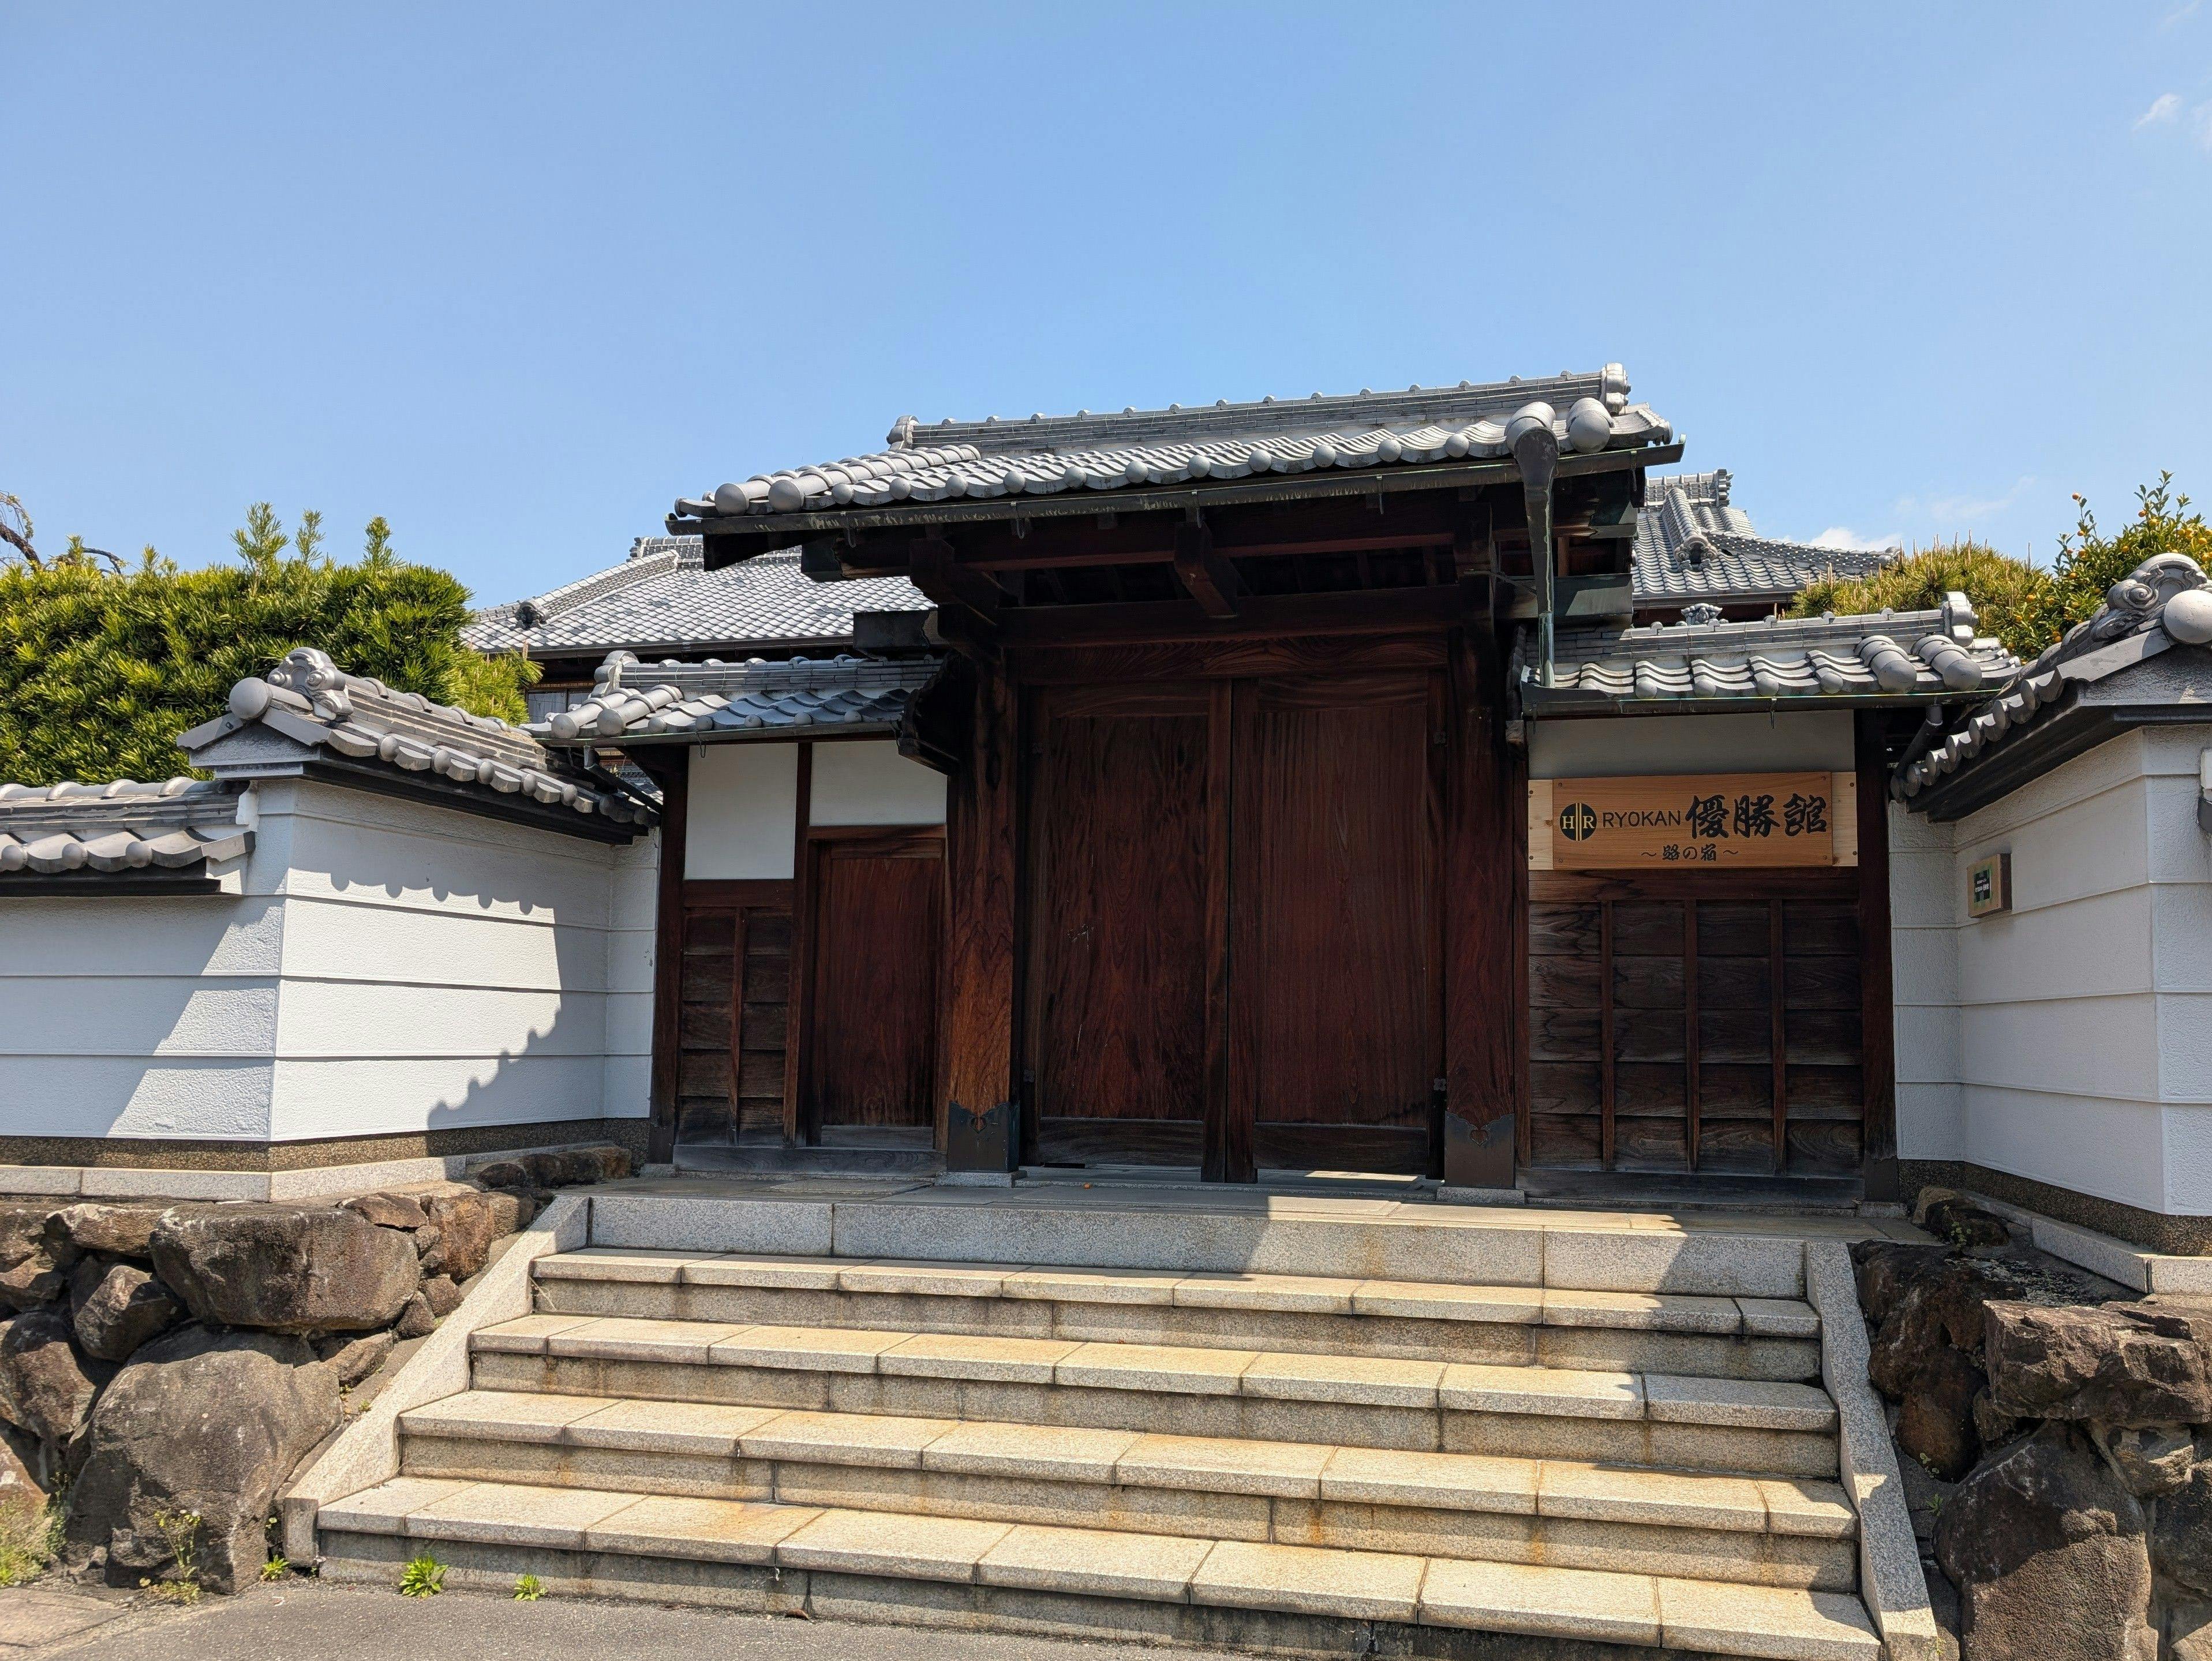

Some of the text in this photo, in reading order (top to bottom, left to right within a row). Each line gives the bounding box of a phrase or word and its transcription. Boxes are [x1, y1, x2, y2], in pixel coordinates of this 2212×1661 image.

[1603, 793, 1827, 839] RYOKAN 優勝館
